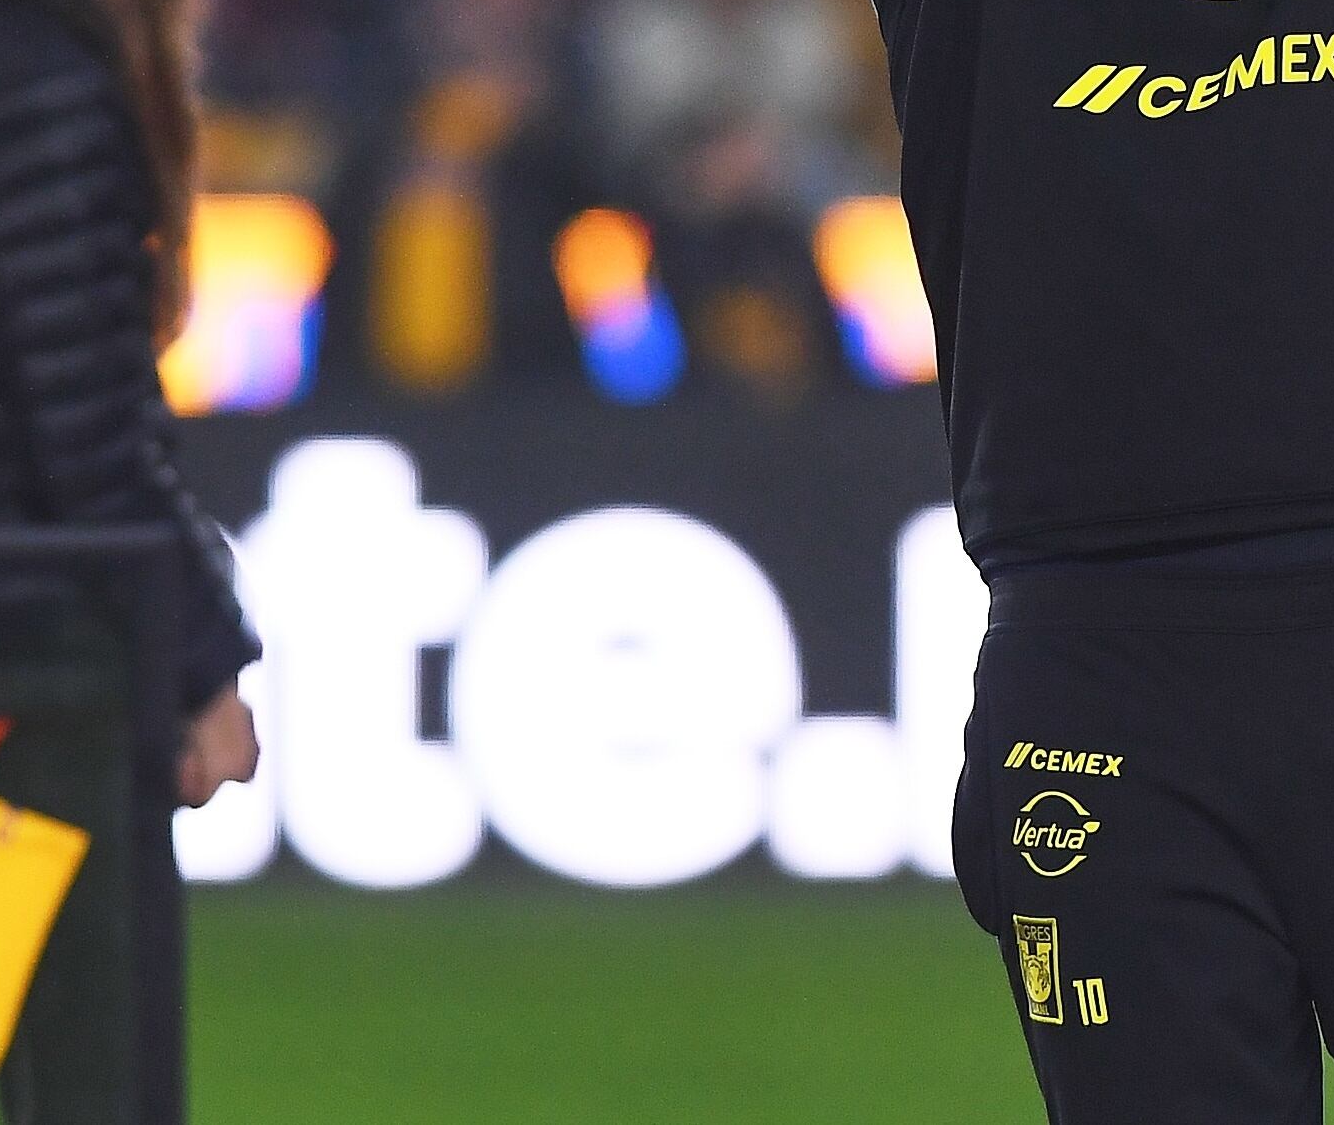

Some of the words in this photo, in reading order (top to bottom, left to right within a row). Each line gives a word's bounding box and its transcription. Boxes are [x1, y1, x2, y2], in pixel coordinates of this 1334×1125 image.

[1030, 748, 1124, 777] CEMEX
[1012, 817, 1086, 849] Vertua
[1017, 925, 1051, 942] GRES
[1072, 978, 1109, 1026] 10
